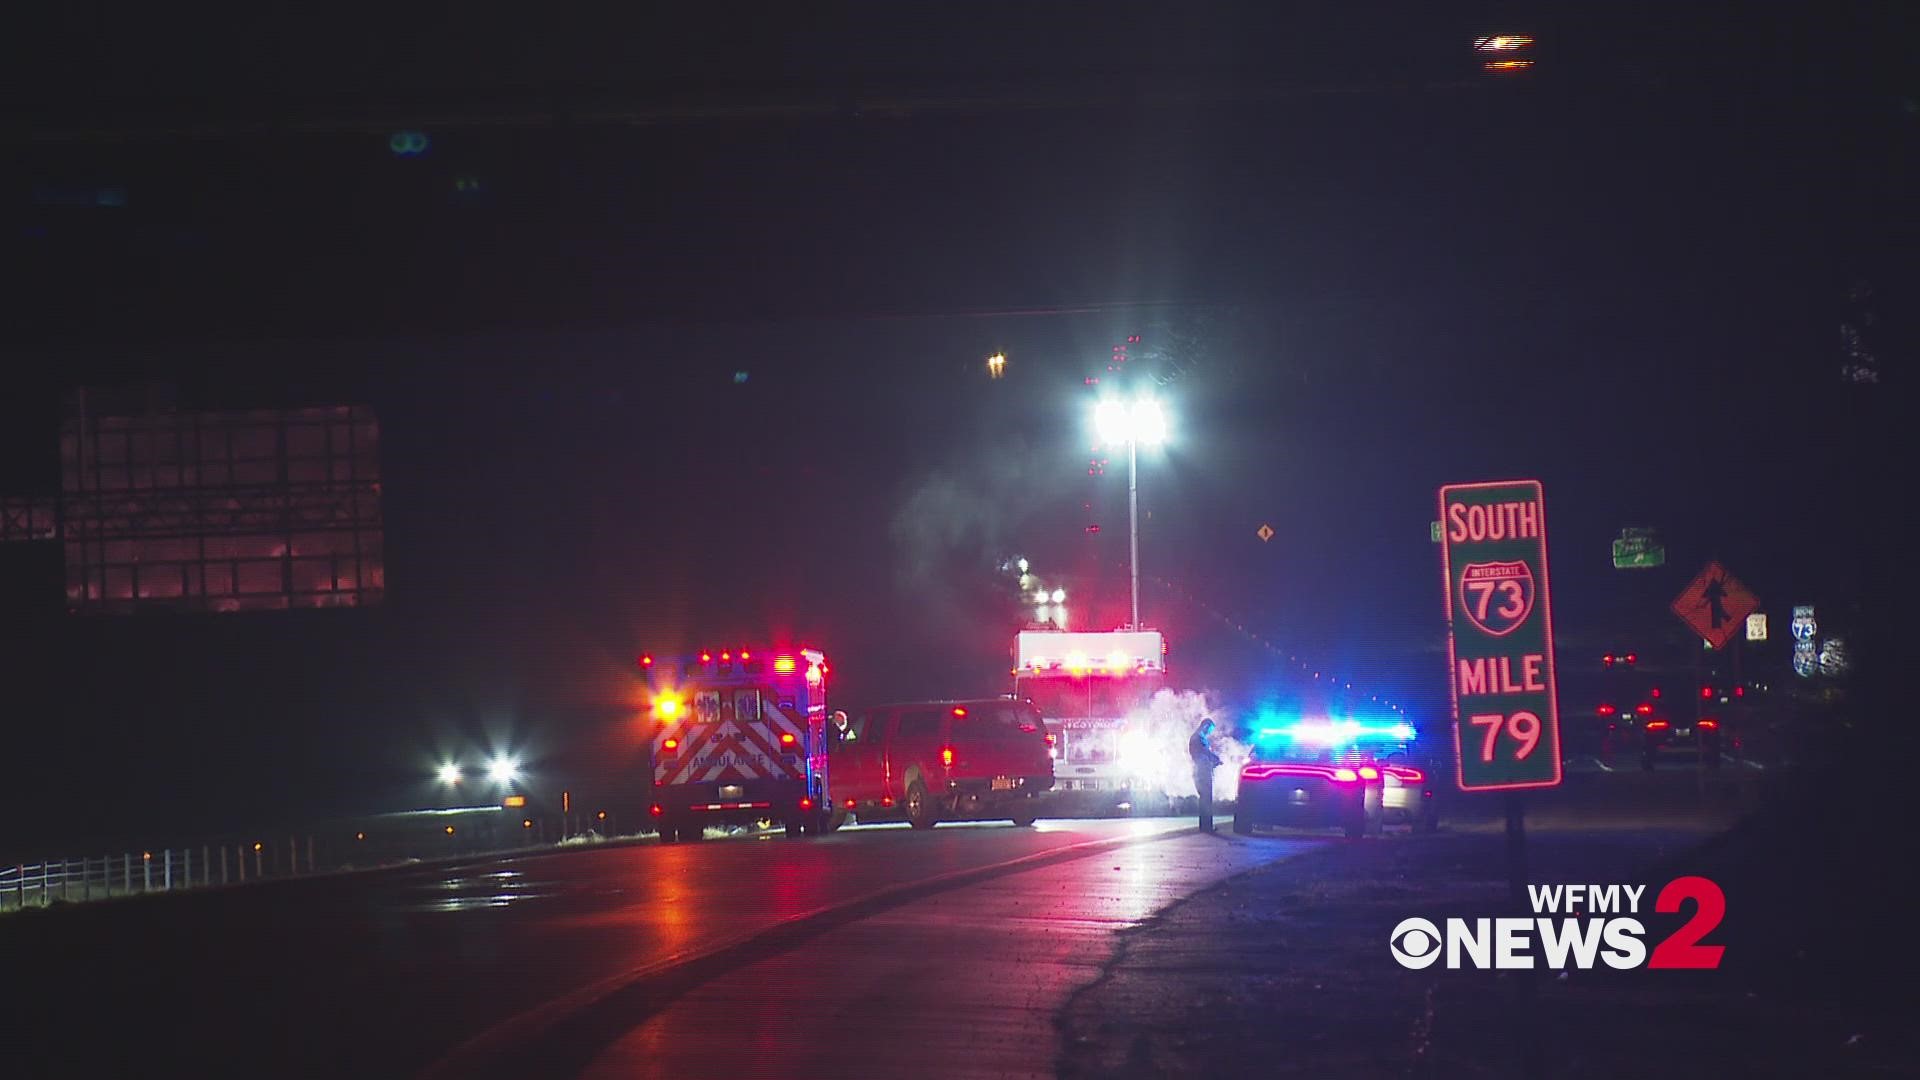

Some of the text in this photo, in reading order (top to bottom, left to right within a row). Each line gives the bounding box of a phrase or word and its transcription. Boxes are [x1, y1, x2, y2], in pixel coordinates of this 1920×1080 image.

[1449, 501, 1538, 542] SOUTH
[1471, 566, 1520, 577] INTERSTATE
[1468, 580, 1524, 620] 73
[1794, 623, 1813, 637] 73
[1459, 655, 1545, 695] MILE
[1471, 711, 1541, 762] 79
[692, 754, 764, 768] AMBULANCE
